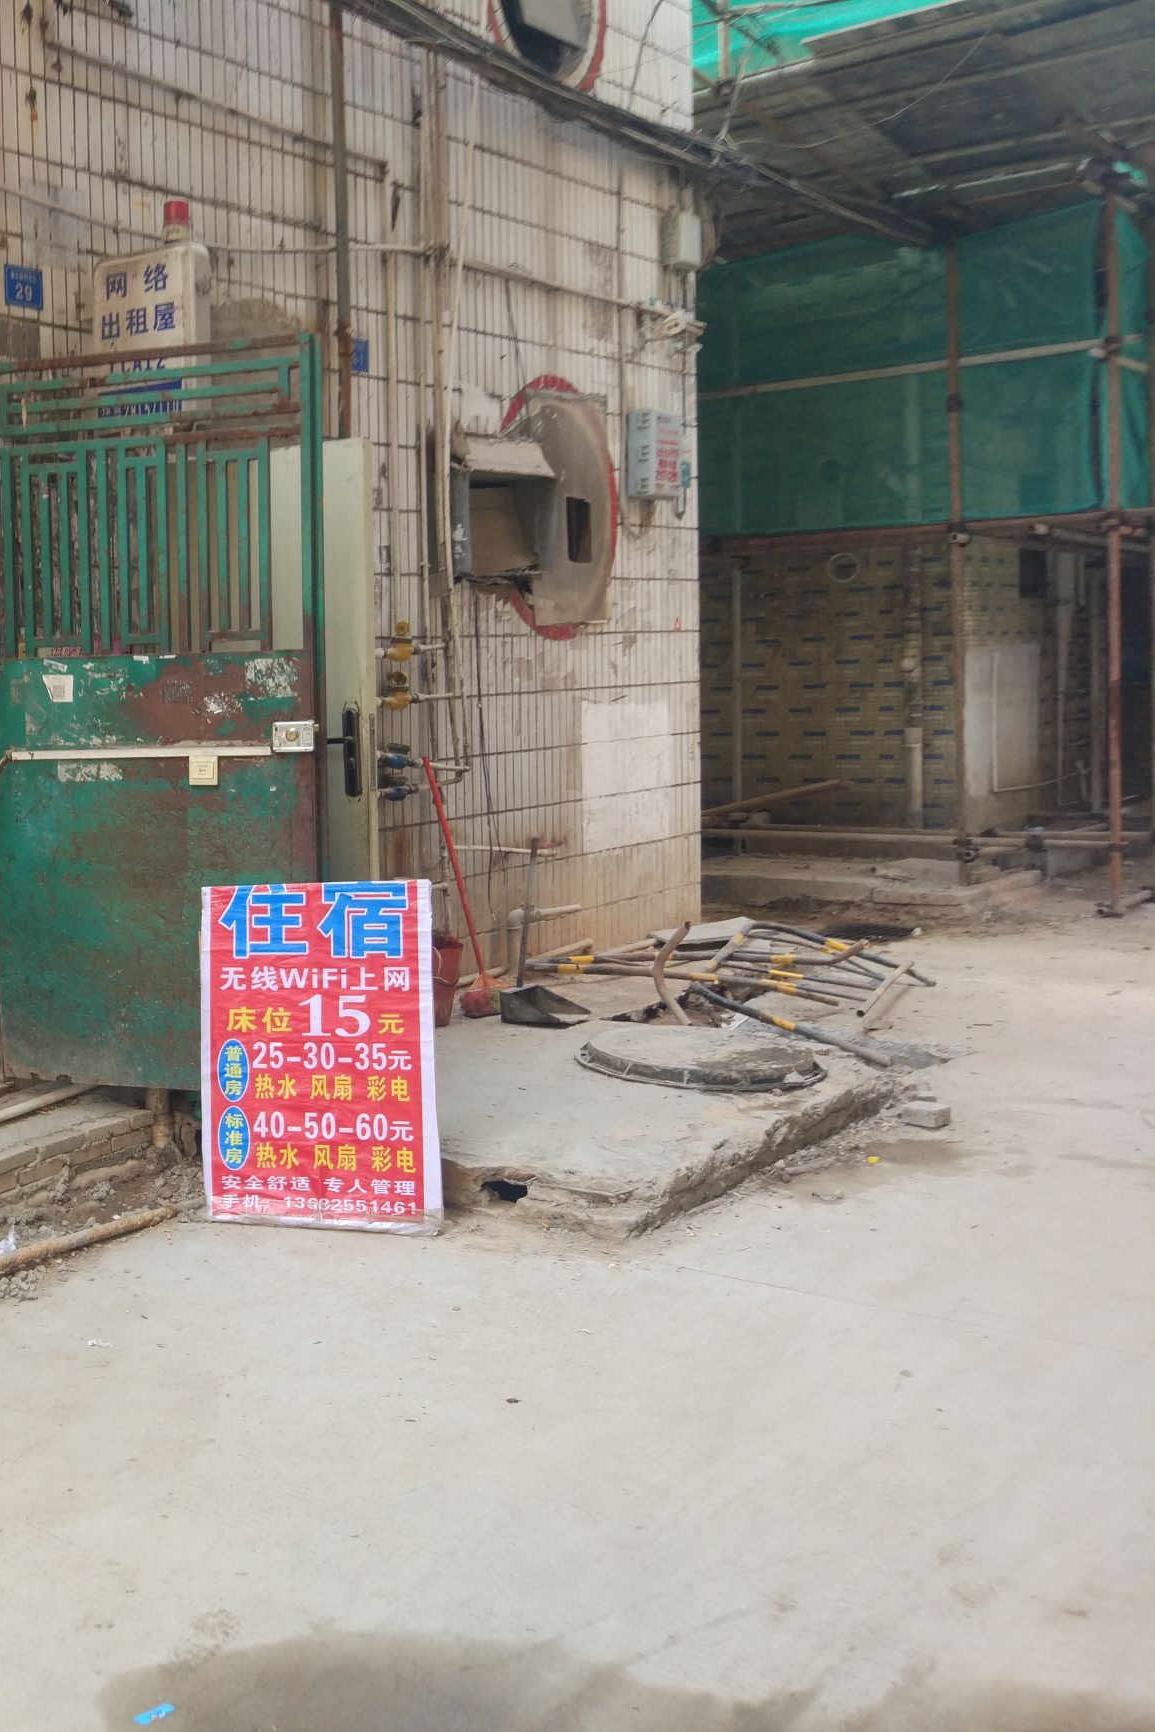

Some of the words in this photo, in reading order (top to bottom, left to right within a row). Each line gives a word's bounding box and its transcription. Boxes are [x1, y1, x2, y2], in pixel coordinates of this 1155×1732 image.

[105, 262, 169, 300] 网络
[101, 302, 176, 341] 出租屋
[219, 881, 409, 959] 住宿
[219, 966, 411, 992] 无线WiFi上网
[224, 1046, 243, 1096] 普通房
[224, 1113, 244, 1164] 标准房
